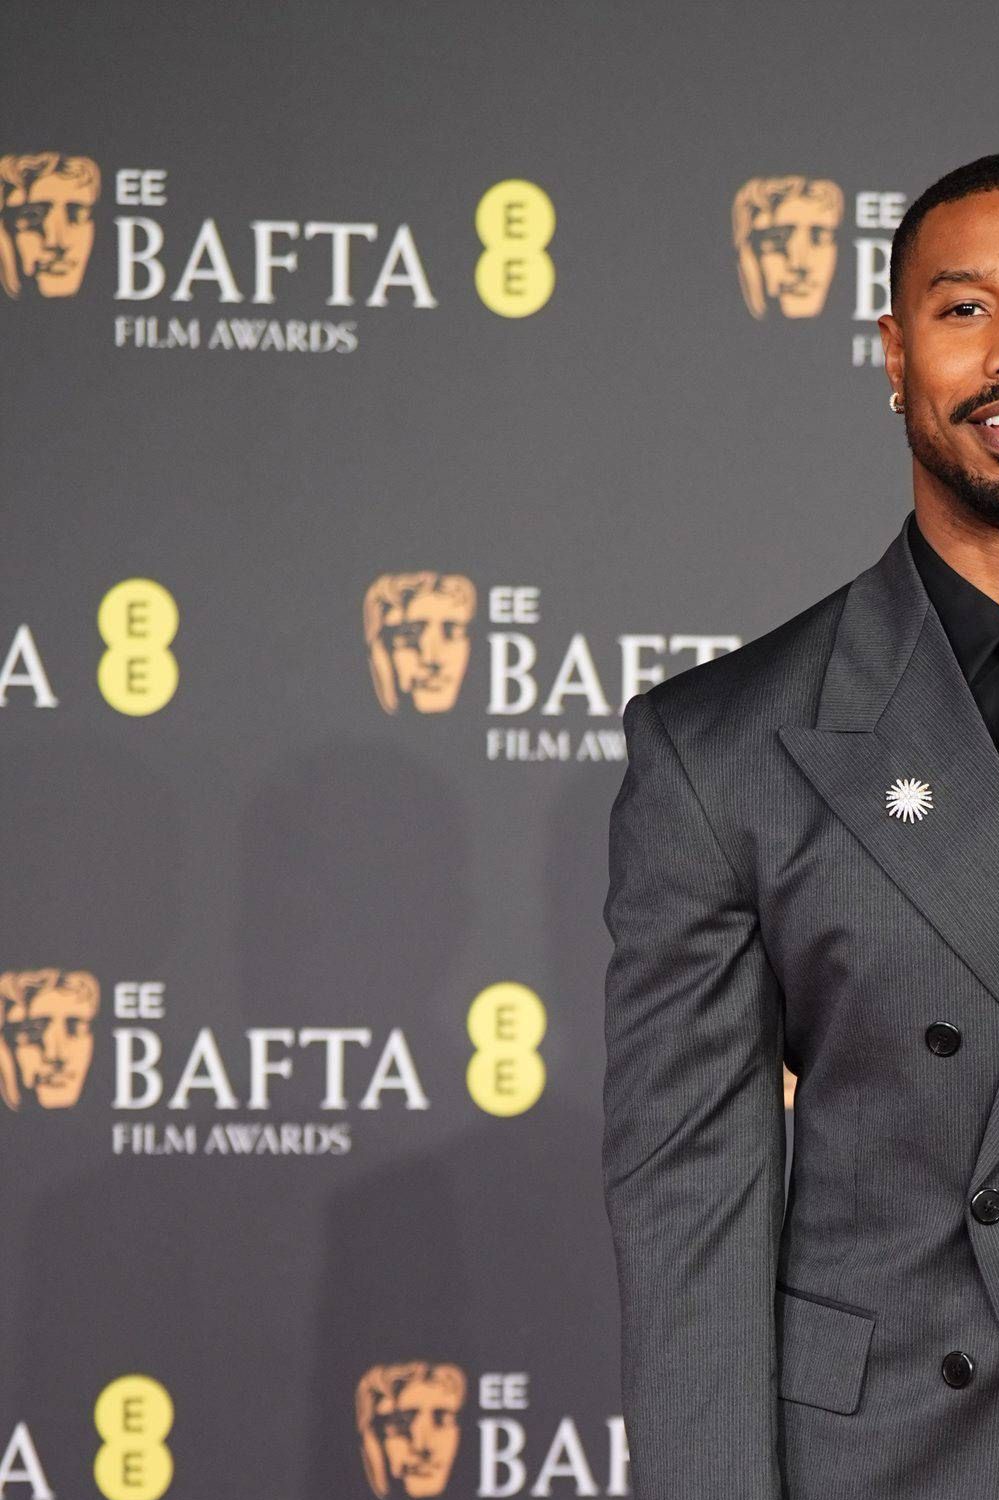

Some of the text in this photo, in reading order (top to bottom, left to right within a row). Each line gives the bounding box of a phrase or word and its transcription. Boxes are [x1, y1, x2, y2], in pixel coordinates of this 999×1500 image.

[116, 169, 166, 206] EE
[116, 217, 436, 308] BAFTA
[115, 316, 358, 352] FILM AWARDS
[489, 587, 539, 623] EE
[487, 729, 570, 760] FILM
[114, 982, 164, 1018] EE
[114, 1028, 428, 1109] BAFTA
[112, 1123, 351, 1154] FILM AWARDS
[479, 1374, 527, 1409] EE
